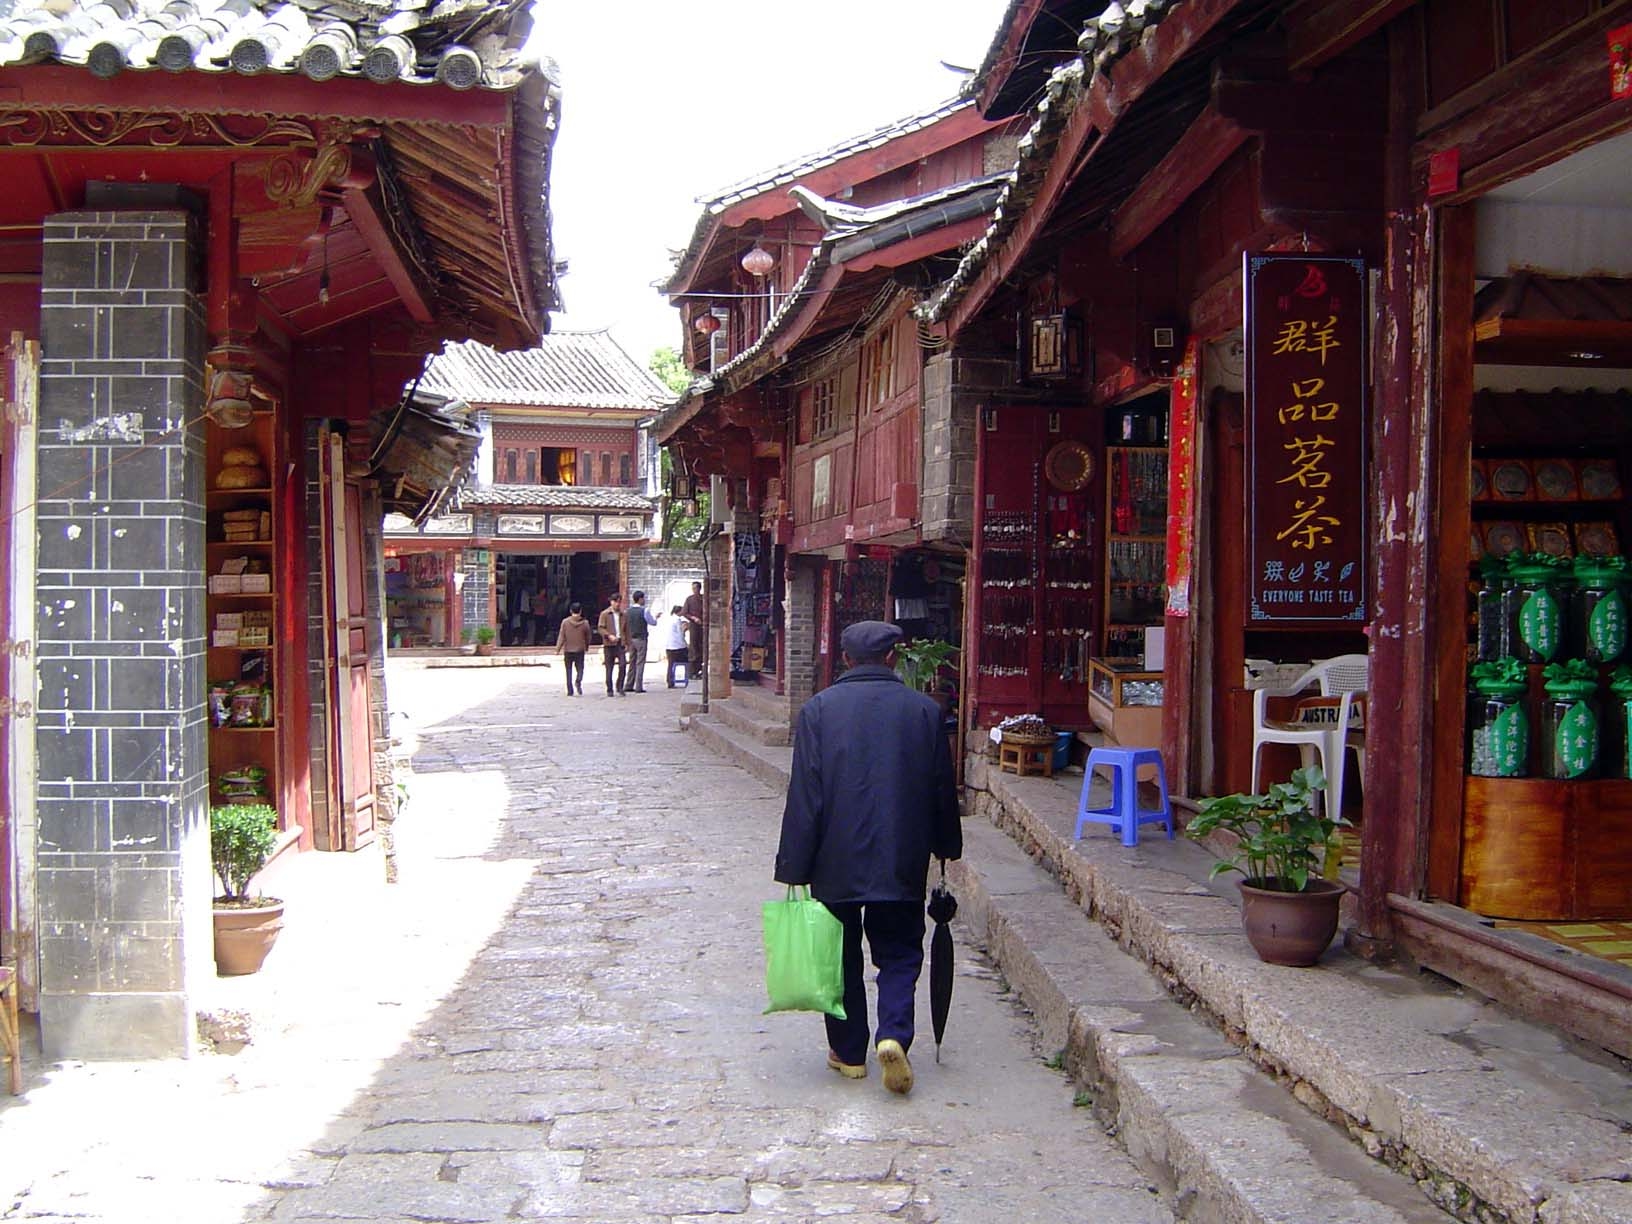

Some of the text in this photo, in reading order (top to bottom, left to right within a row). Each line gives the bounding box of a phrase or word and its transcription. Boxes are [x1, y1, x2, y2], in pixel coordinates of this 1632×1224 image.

[1272, 315, 1342, 550] 群品茗茶
[1263, 590, 1354, 603] EVERYONE TASTE TEA
[1302, 703, 1360, 723] AUSTRIA
